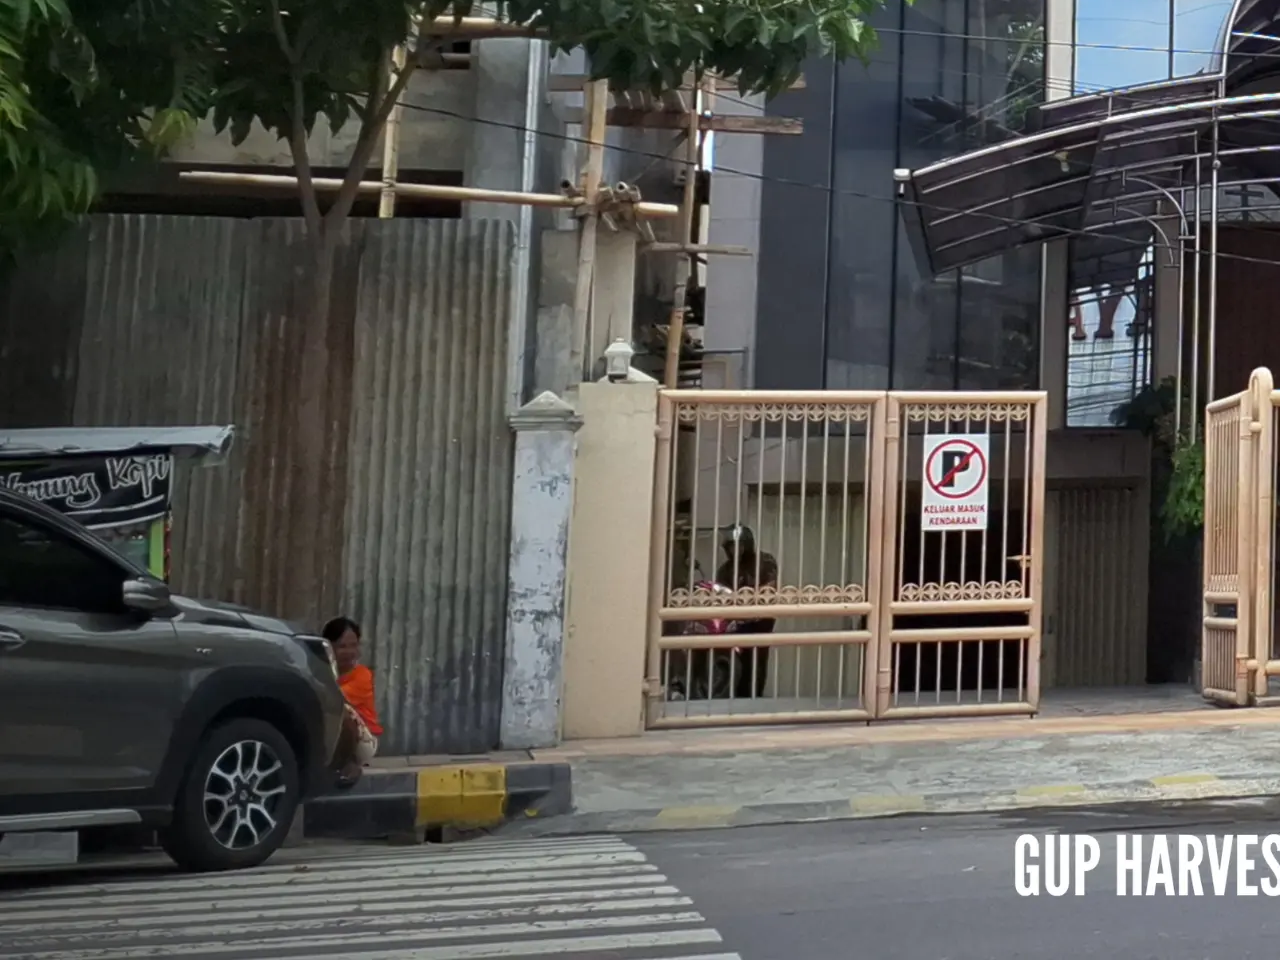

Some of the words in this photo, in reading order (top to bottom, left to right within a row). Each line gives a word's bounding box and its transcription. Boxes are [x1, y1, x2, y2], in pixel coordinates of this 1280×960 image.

[105, 454, 169, 499] Kopi
[924, 504, 956, 514] KELUAR
[957, 504, 985, 513] MASUK
[929, 516, 978, 526] KENDARAAN
